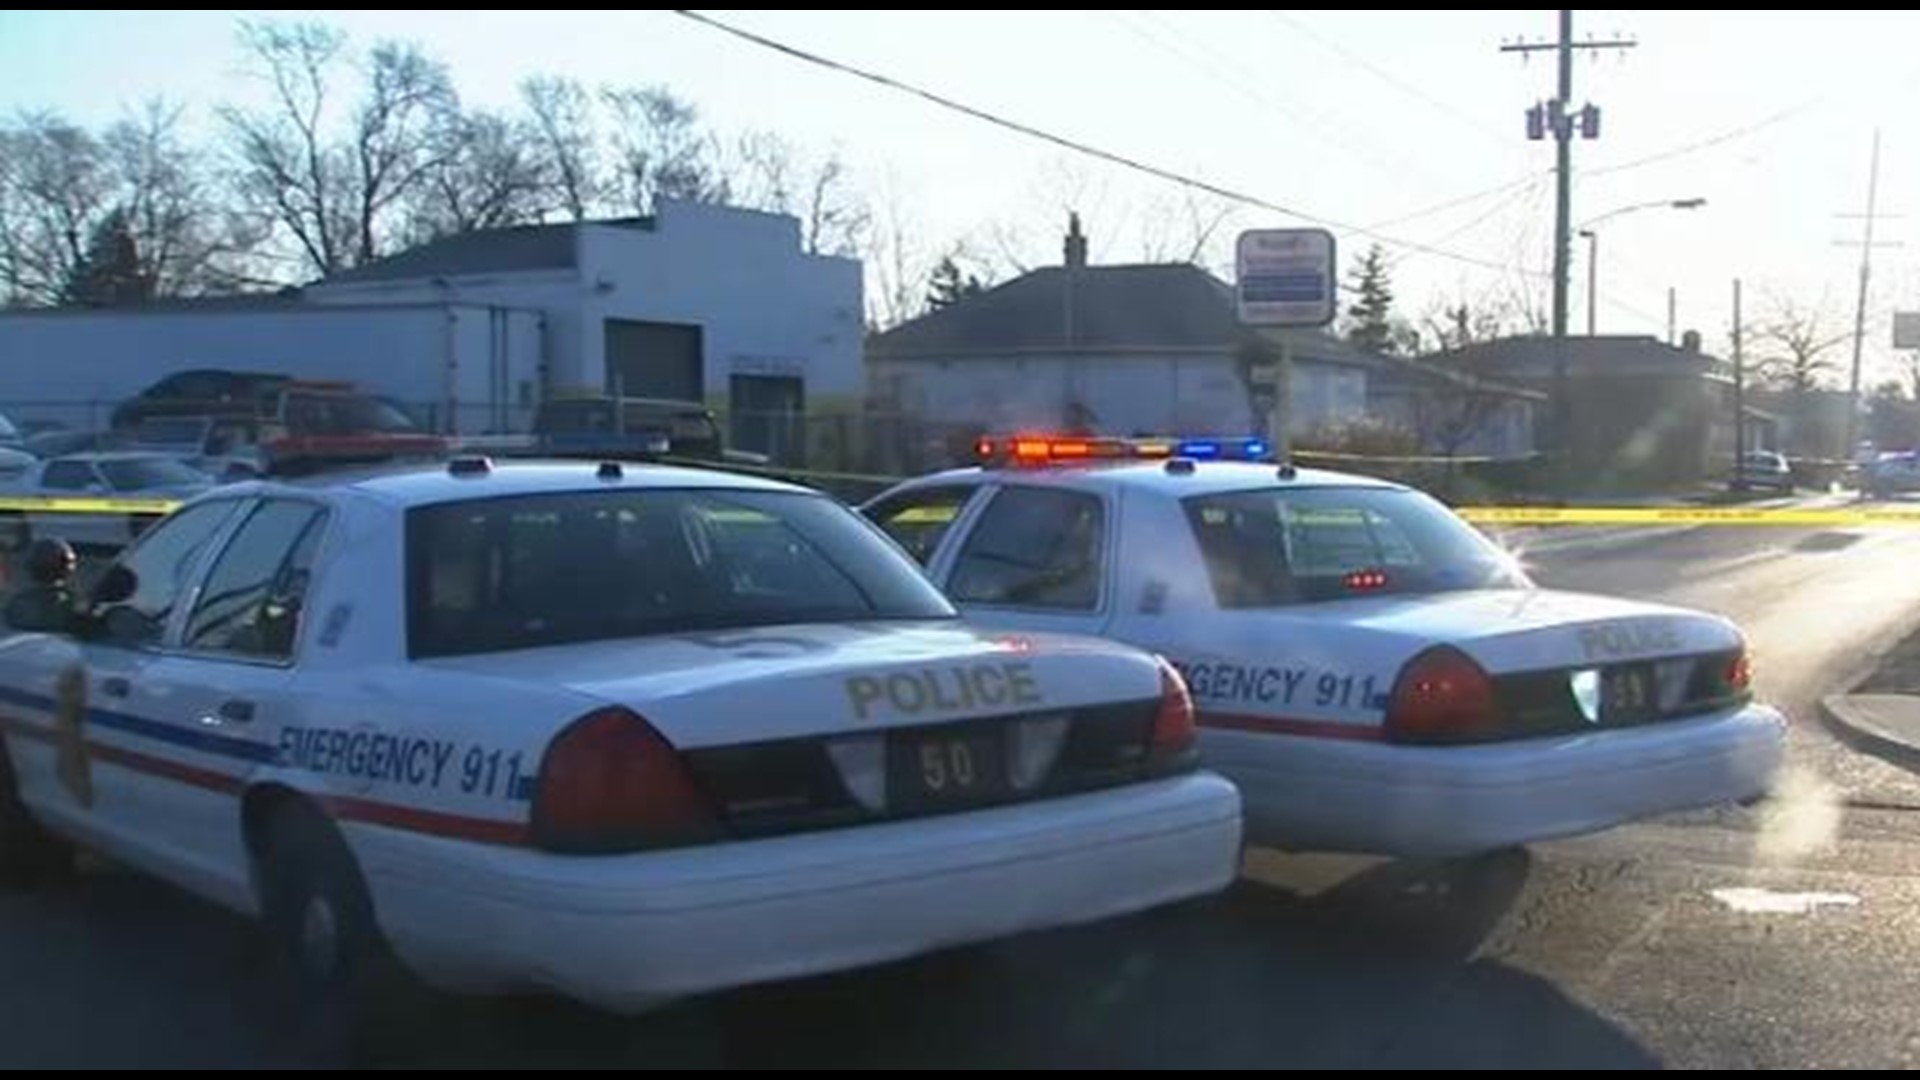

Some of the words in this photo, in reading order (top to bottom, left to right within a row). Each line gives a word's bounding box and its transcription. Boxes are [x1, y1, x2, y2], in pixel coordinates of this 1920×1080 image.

[1578, 624, 1684, 660] POLICE
[846, 662, 1040, 719] POLICE
[1315, 673, 1377, 710] 911
[280, 726, 454, 788] EMERGENCY
[461, 746, 522, 801] 911
[921, 742, 975, 789] 50
